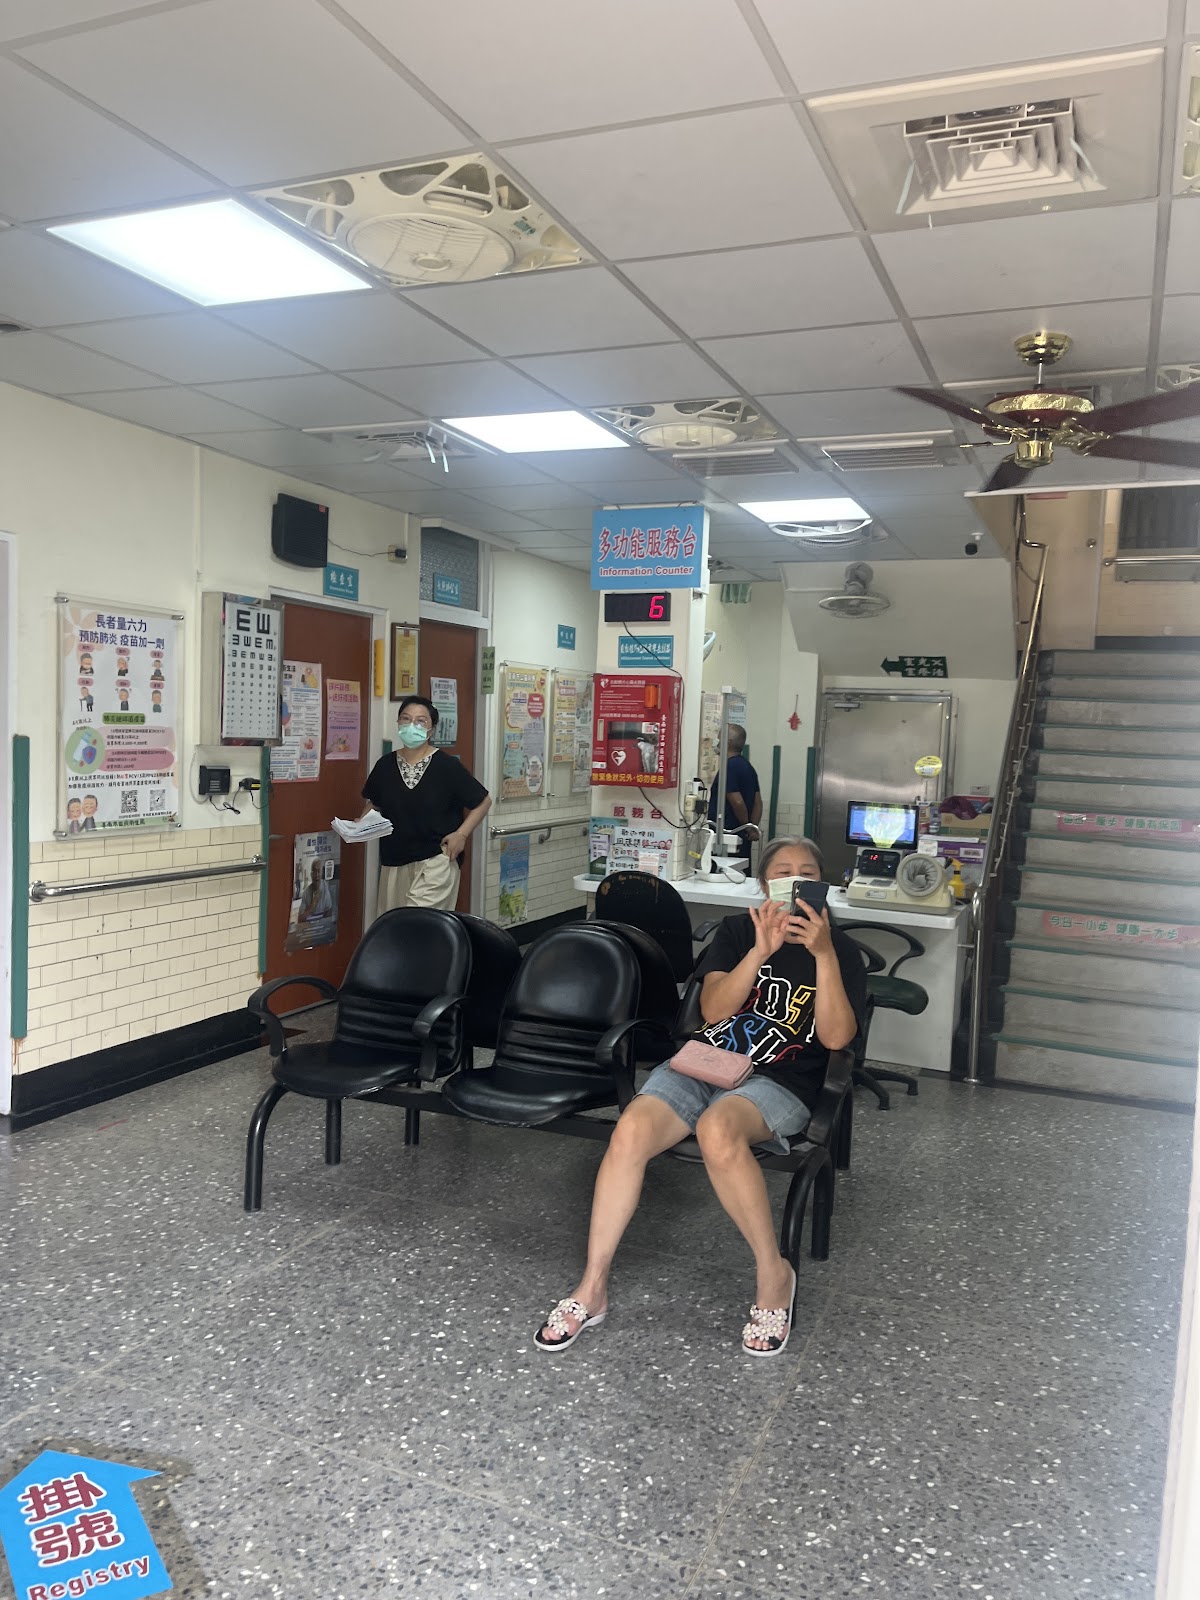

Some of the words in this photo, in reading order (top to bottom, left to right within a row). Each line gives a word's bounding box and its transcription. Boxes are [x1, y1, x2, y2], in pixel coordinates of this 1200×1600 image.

[597, 524, 697, 562] 多功能服務台
[599, 567, 653, 577] Information
[655, 566, 694, 576] Counter
[649, 595, 665, 619] 6
[96, 614, 147, 633] 長者量六力
[79, 630, 118, 645] 預防肺炎
[120, 634, 165, 649] 疫苗加一劑
[613, 806, 663, 820] 服務台
[18, 1472, 124, 1568] 掛號
[28, 1556, 150, 1600] Registry
